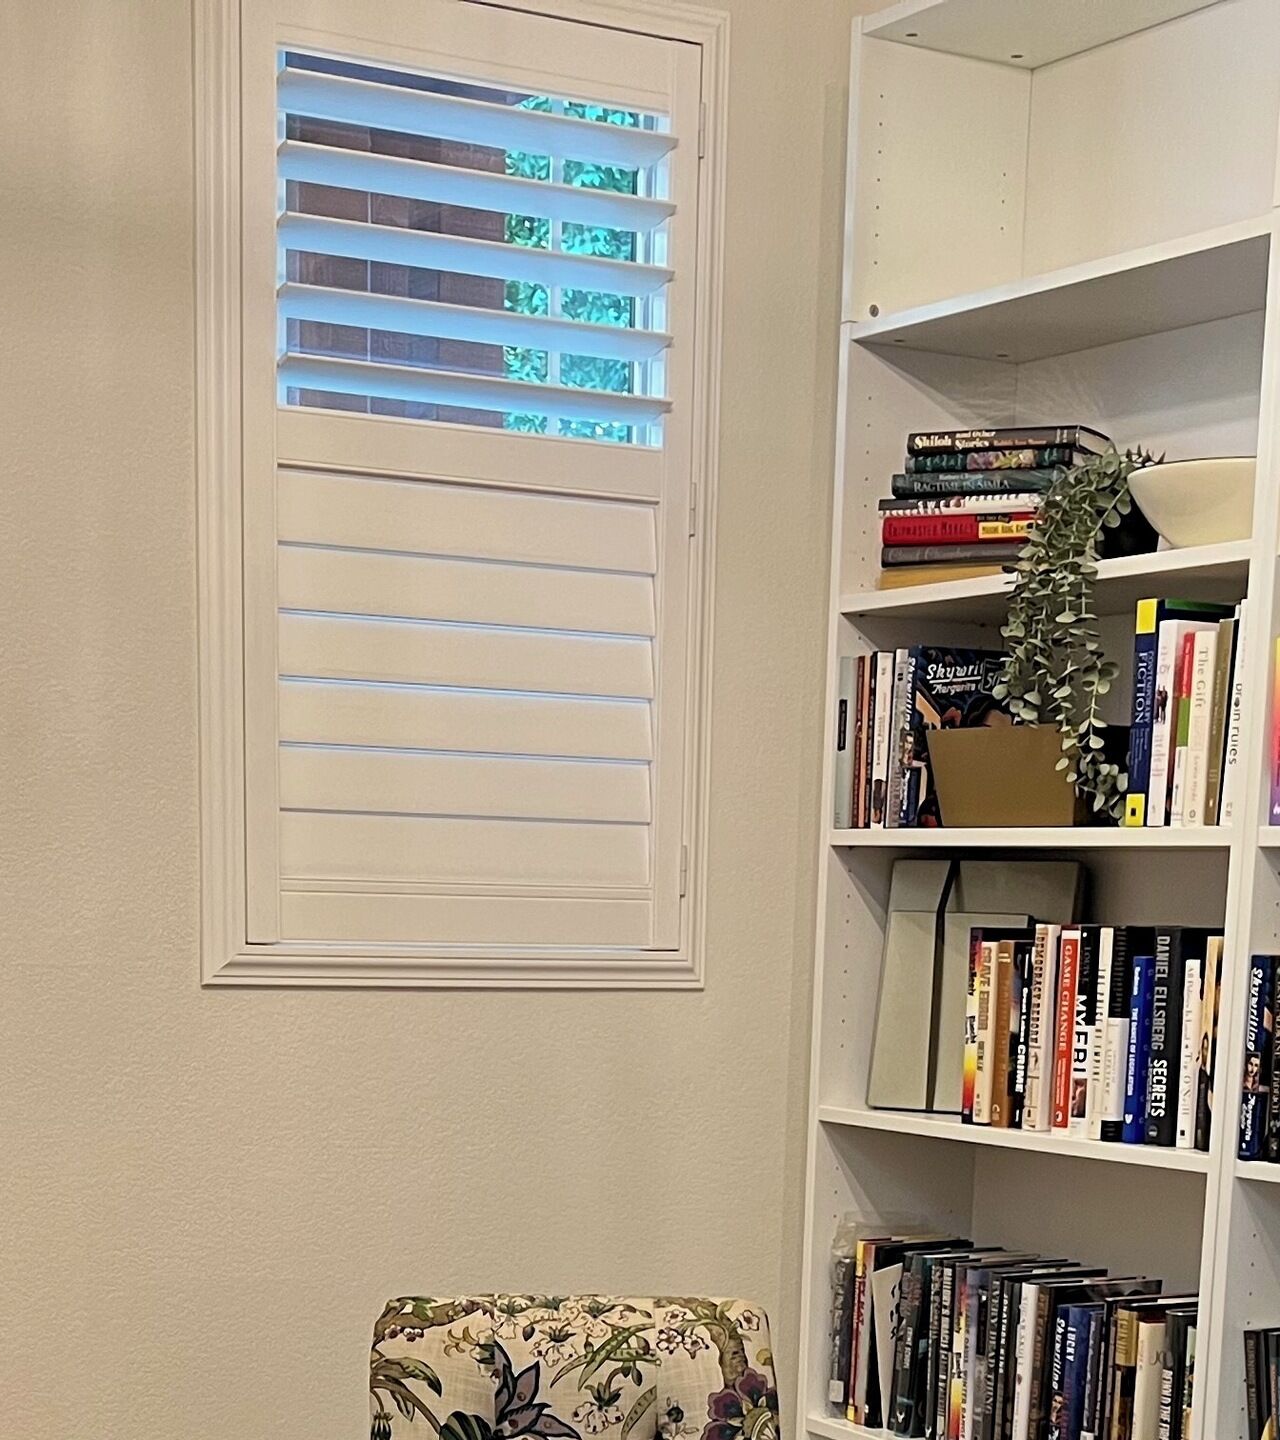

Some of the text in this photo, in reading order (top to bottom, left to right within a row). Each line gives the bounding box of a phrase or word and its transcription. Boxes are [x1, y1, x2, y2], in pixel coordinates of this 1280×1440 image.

[914, 435, 951, 450] Shiloh
[1135, 652, 1148, 724] FICTION
[1228, 728, 1239, 765] rules
[1059, 945, 1073, 1051] GAME CHANGE
[1151, 936, 1170, 1050] DANIEL ELLSBERG
[1151, 1059, 1167, 1117] SECRETS
